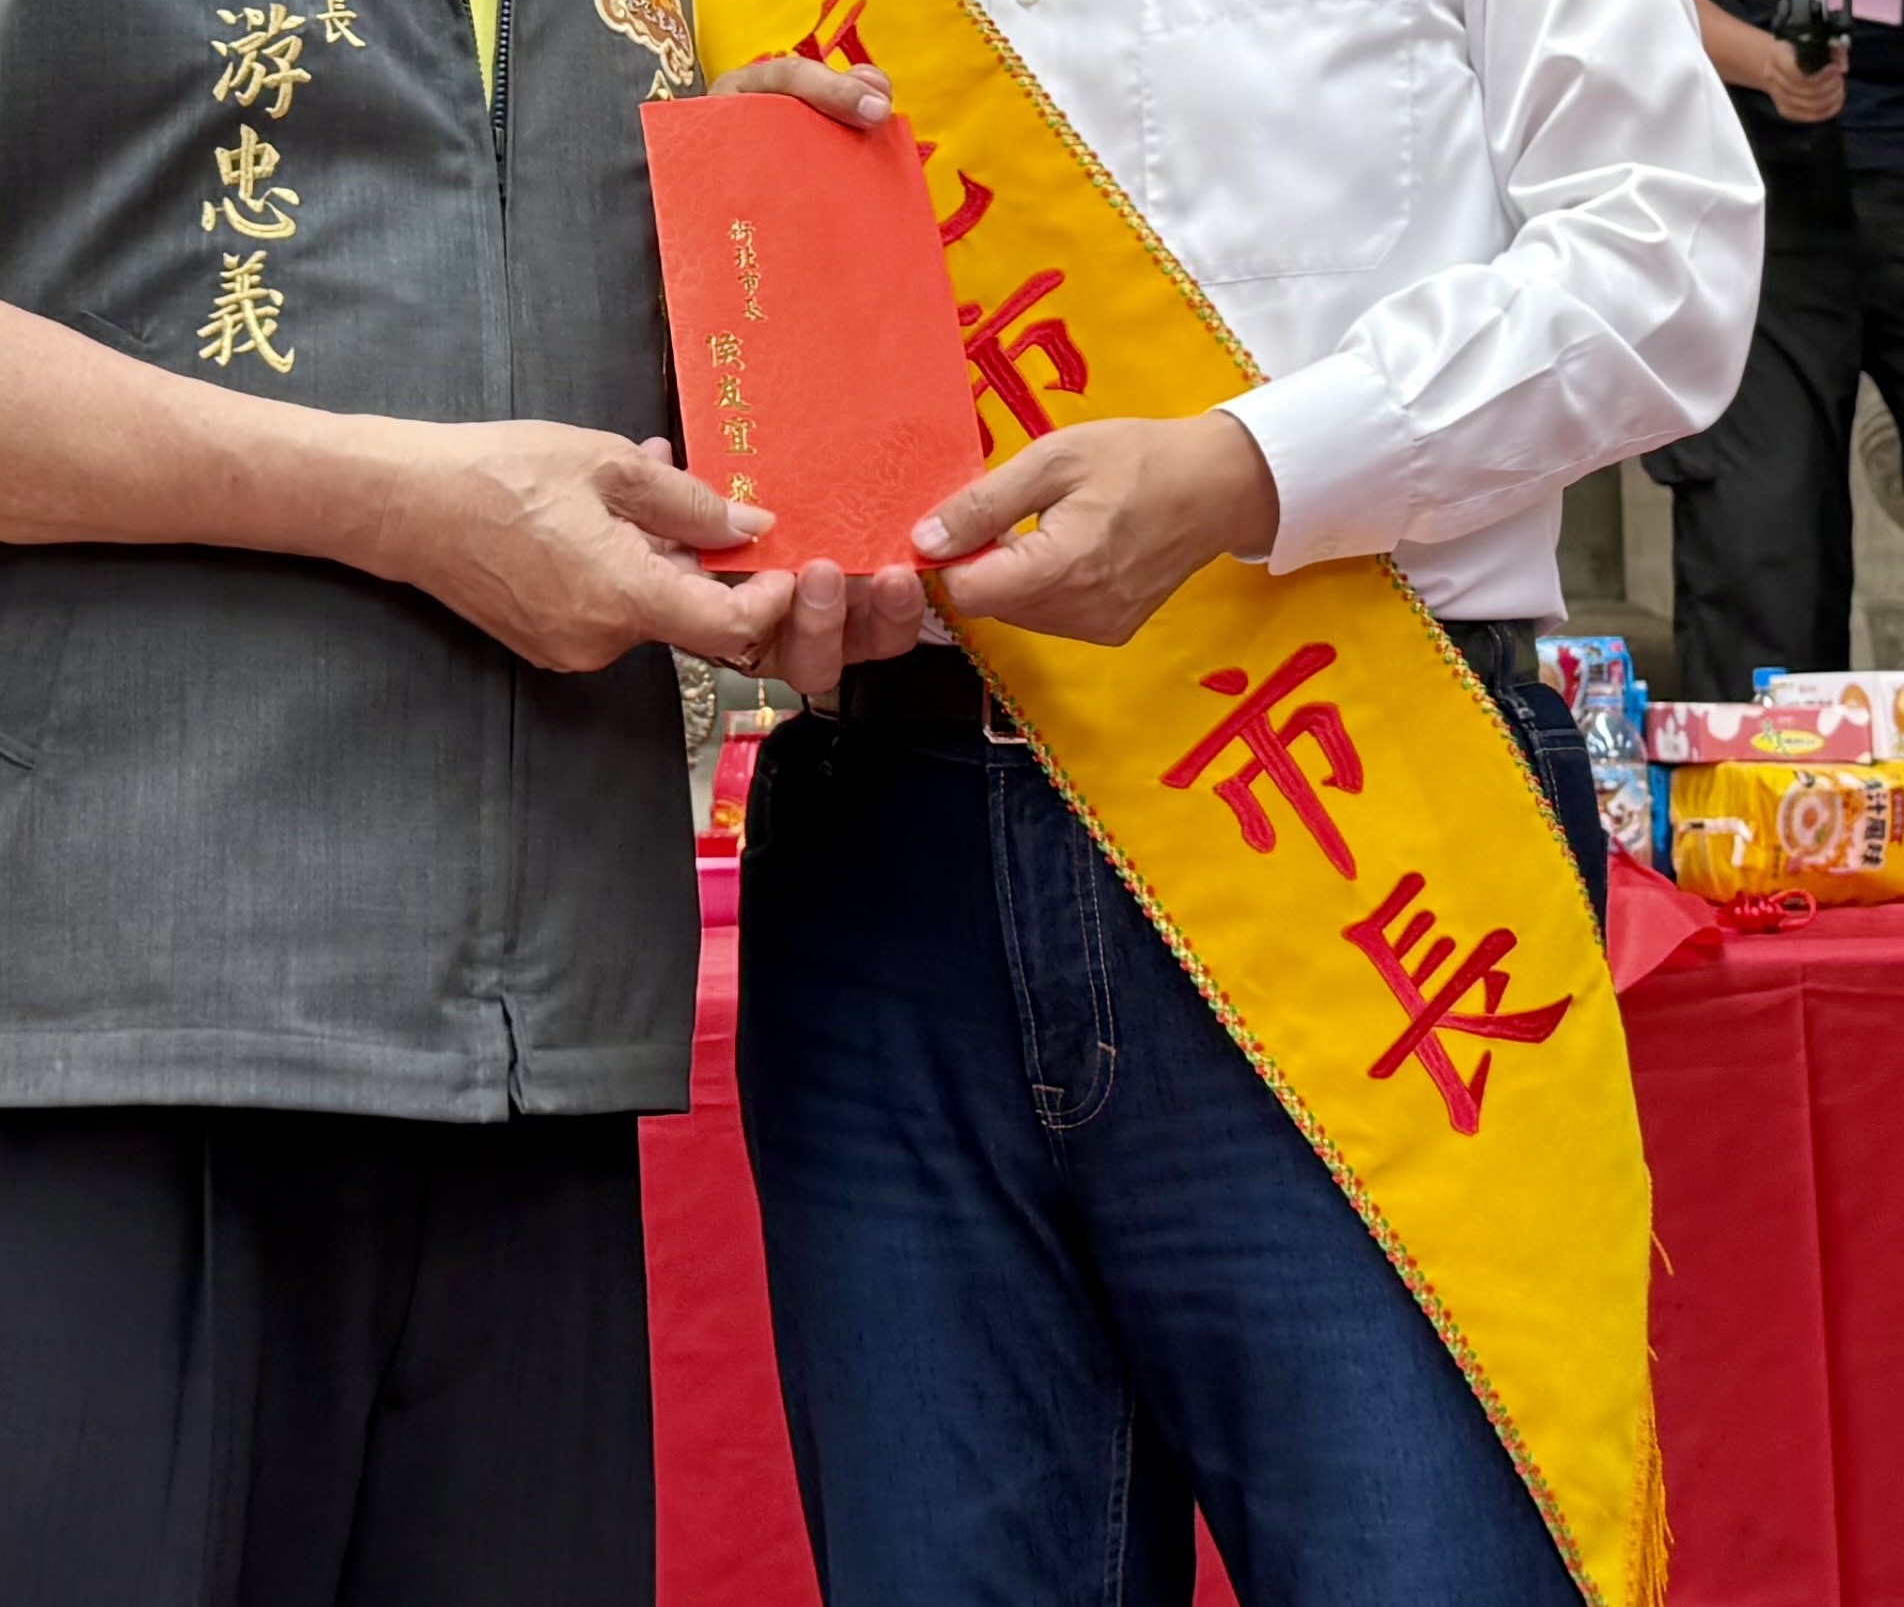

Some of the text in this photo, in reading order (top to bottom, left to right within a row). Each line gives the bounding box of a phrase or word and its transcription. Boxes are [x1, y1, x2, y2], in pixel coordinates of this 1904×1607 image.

[196, 2, 312, 374] 游忠義
[727, 218, 769, 322] 新北市長
[705, 330, 759, 456] 侯友宜
